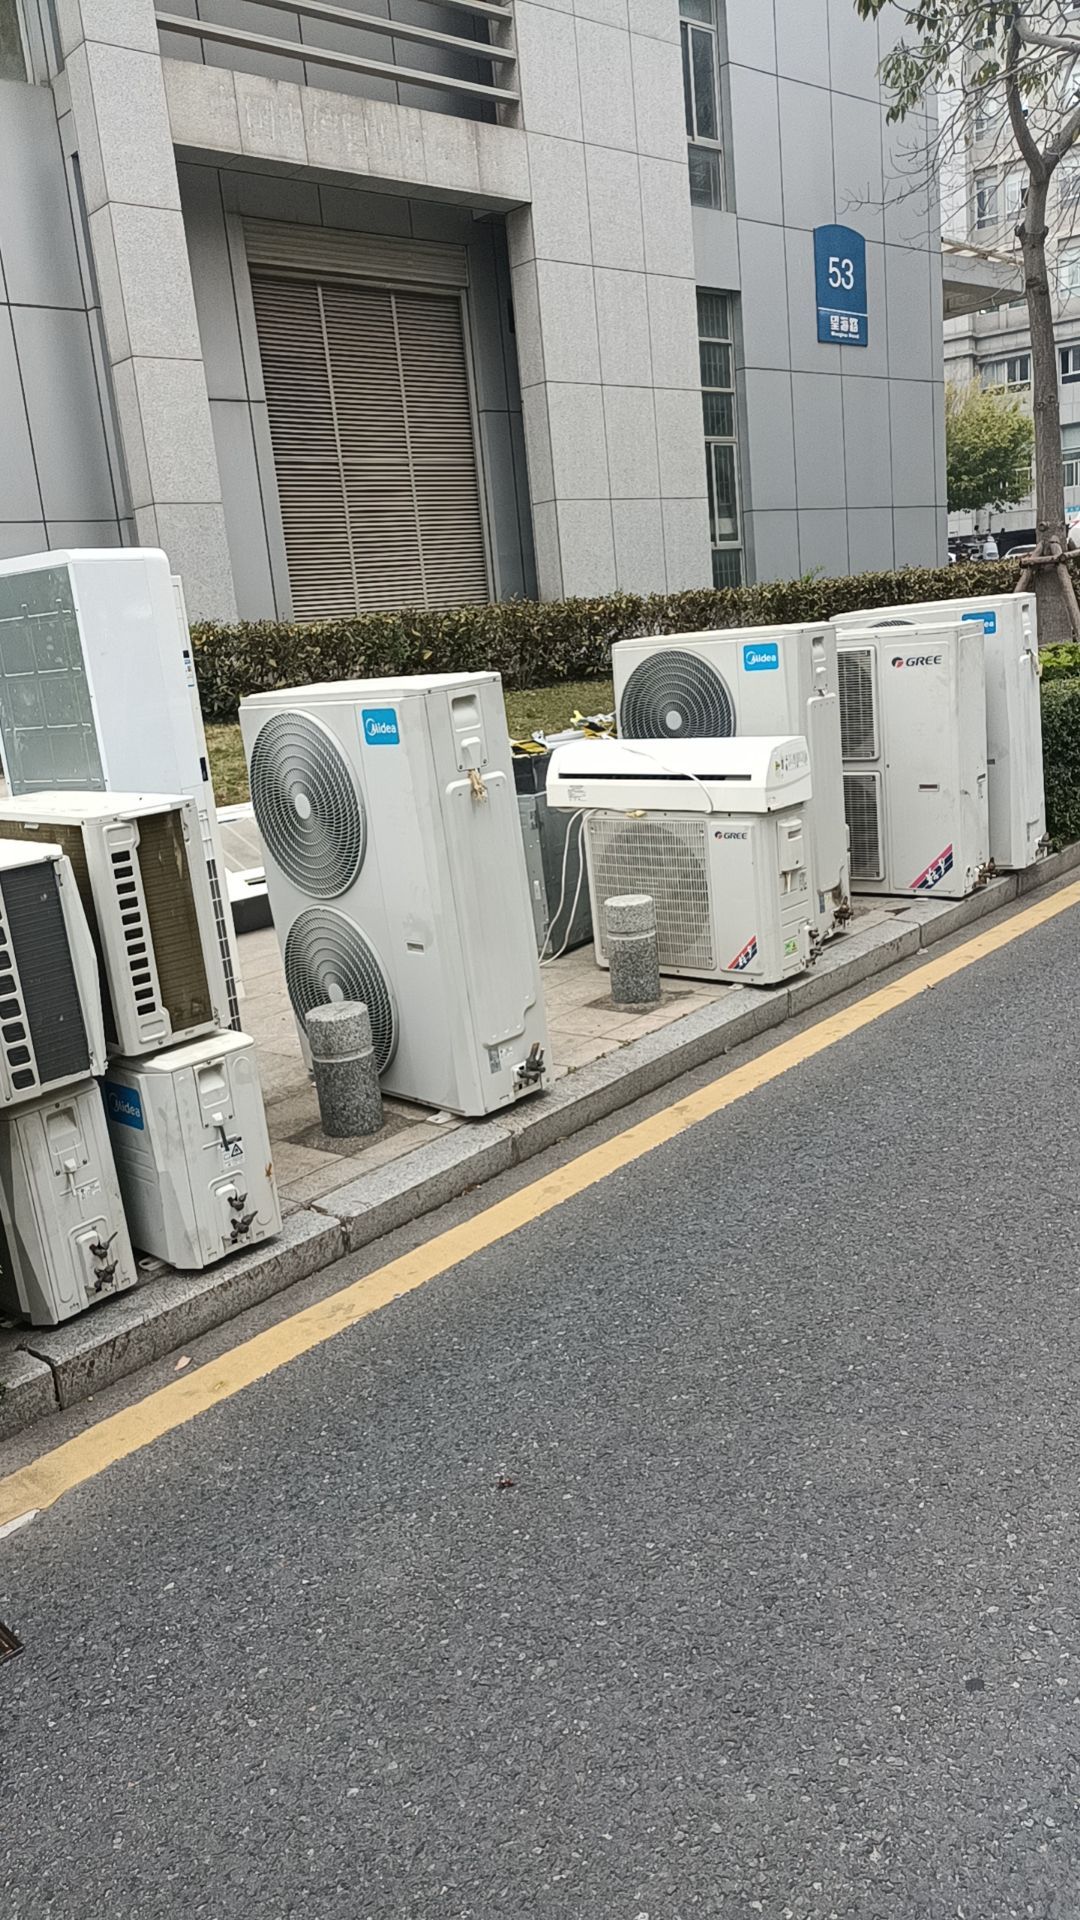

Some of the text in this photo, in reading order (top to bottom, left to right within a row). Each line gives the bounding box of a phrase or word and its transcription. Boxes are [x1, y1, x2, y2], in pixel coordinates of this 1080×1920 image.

[828, 256, 854, 290] 53
[745, 650, 777, 665] Midea
[906, 654, 943, 667] GREE
[365, 717, 397, 736] Midea
[723, 831, 748, 840] GREE
[109, 1092, 141, 1118] Midea
